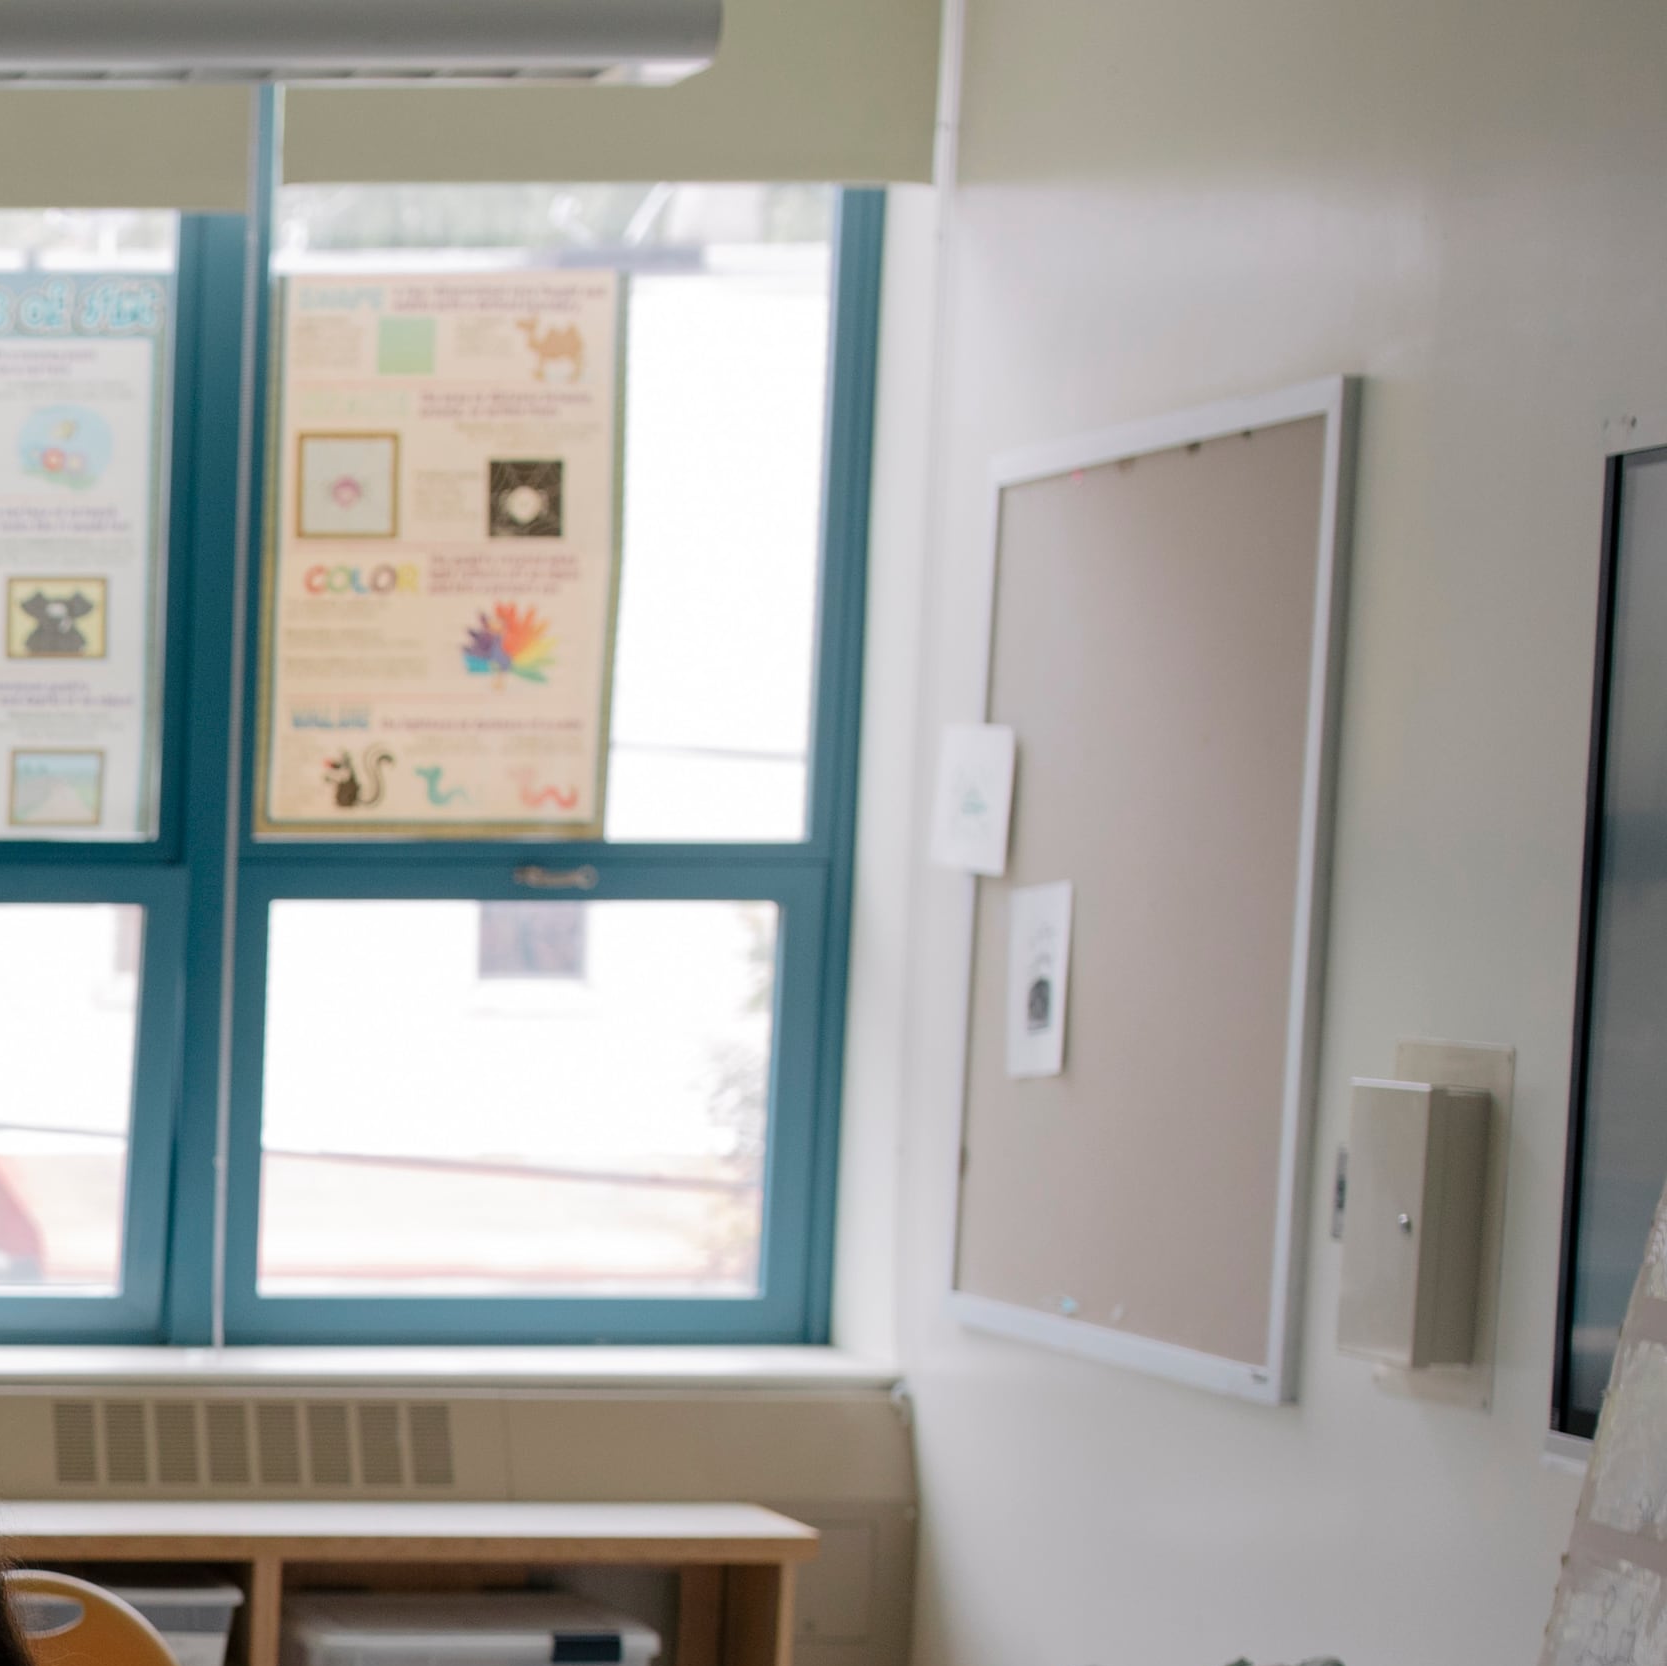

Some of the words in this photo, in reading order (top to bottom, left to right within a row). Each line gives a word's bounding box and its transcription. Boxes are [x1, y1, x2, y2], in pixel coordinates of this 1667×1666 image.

[20, 281, 68, 327] of
[80, 284, 156, 327] Art
[303, 564, 420, 594] COLOR
